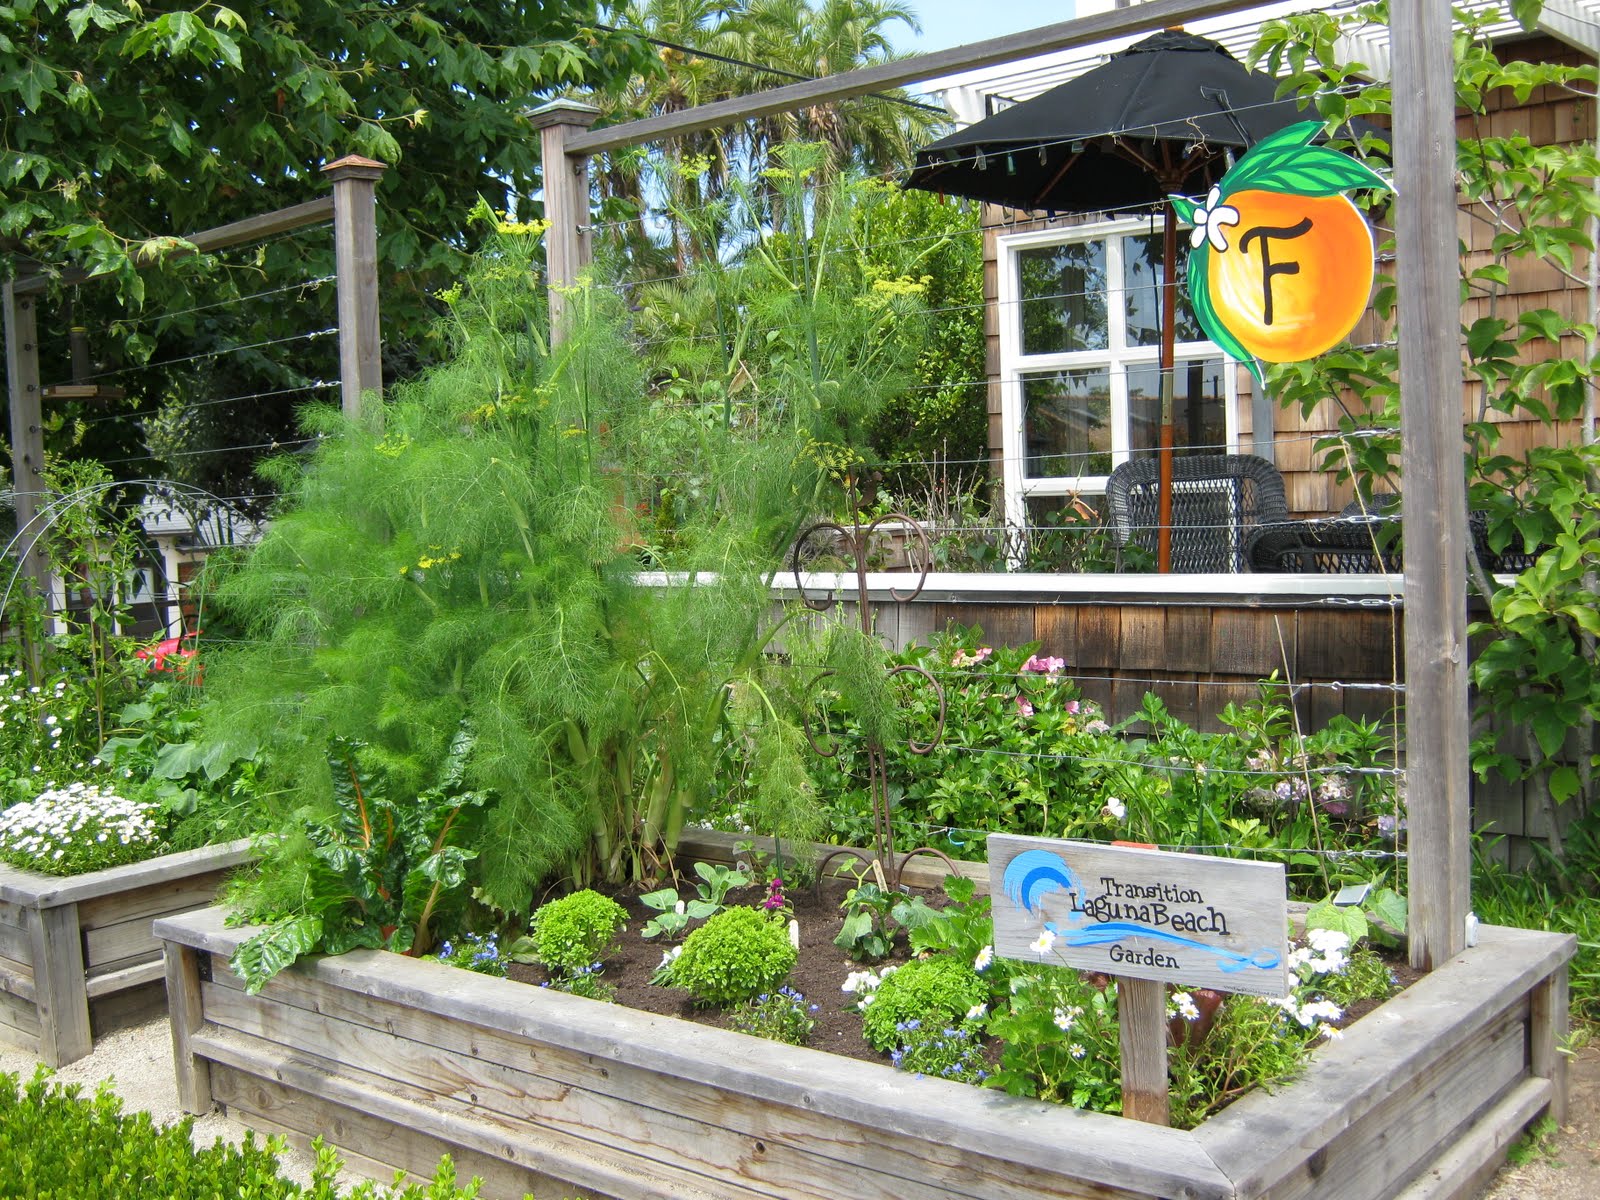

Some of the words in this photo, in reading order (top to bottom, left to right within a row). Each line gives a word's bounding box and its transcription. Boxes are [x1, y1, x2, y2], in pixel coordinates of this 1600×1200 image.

[1239, 216, 1314, 326] F
[1100, 877, 1204, 904] Transition
[1109, 944, 1180, 970] Garden
